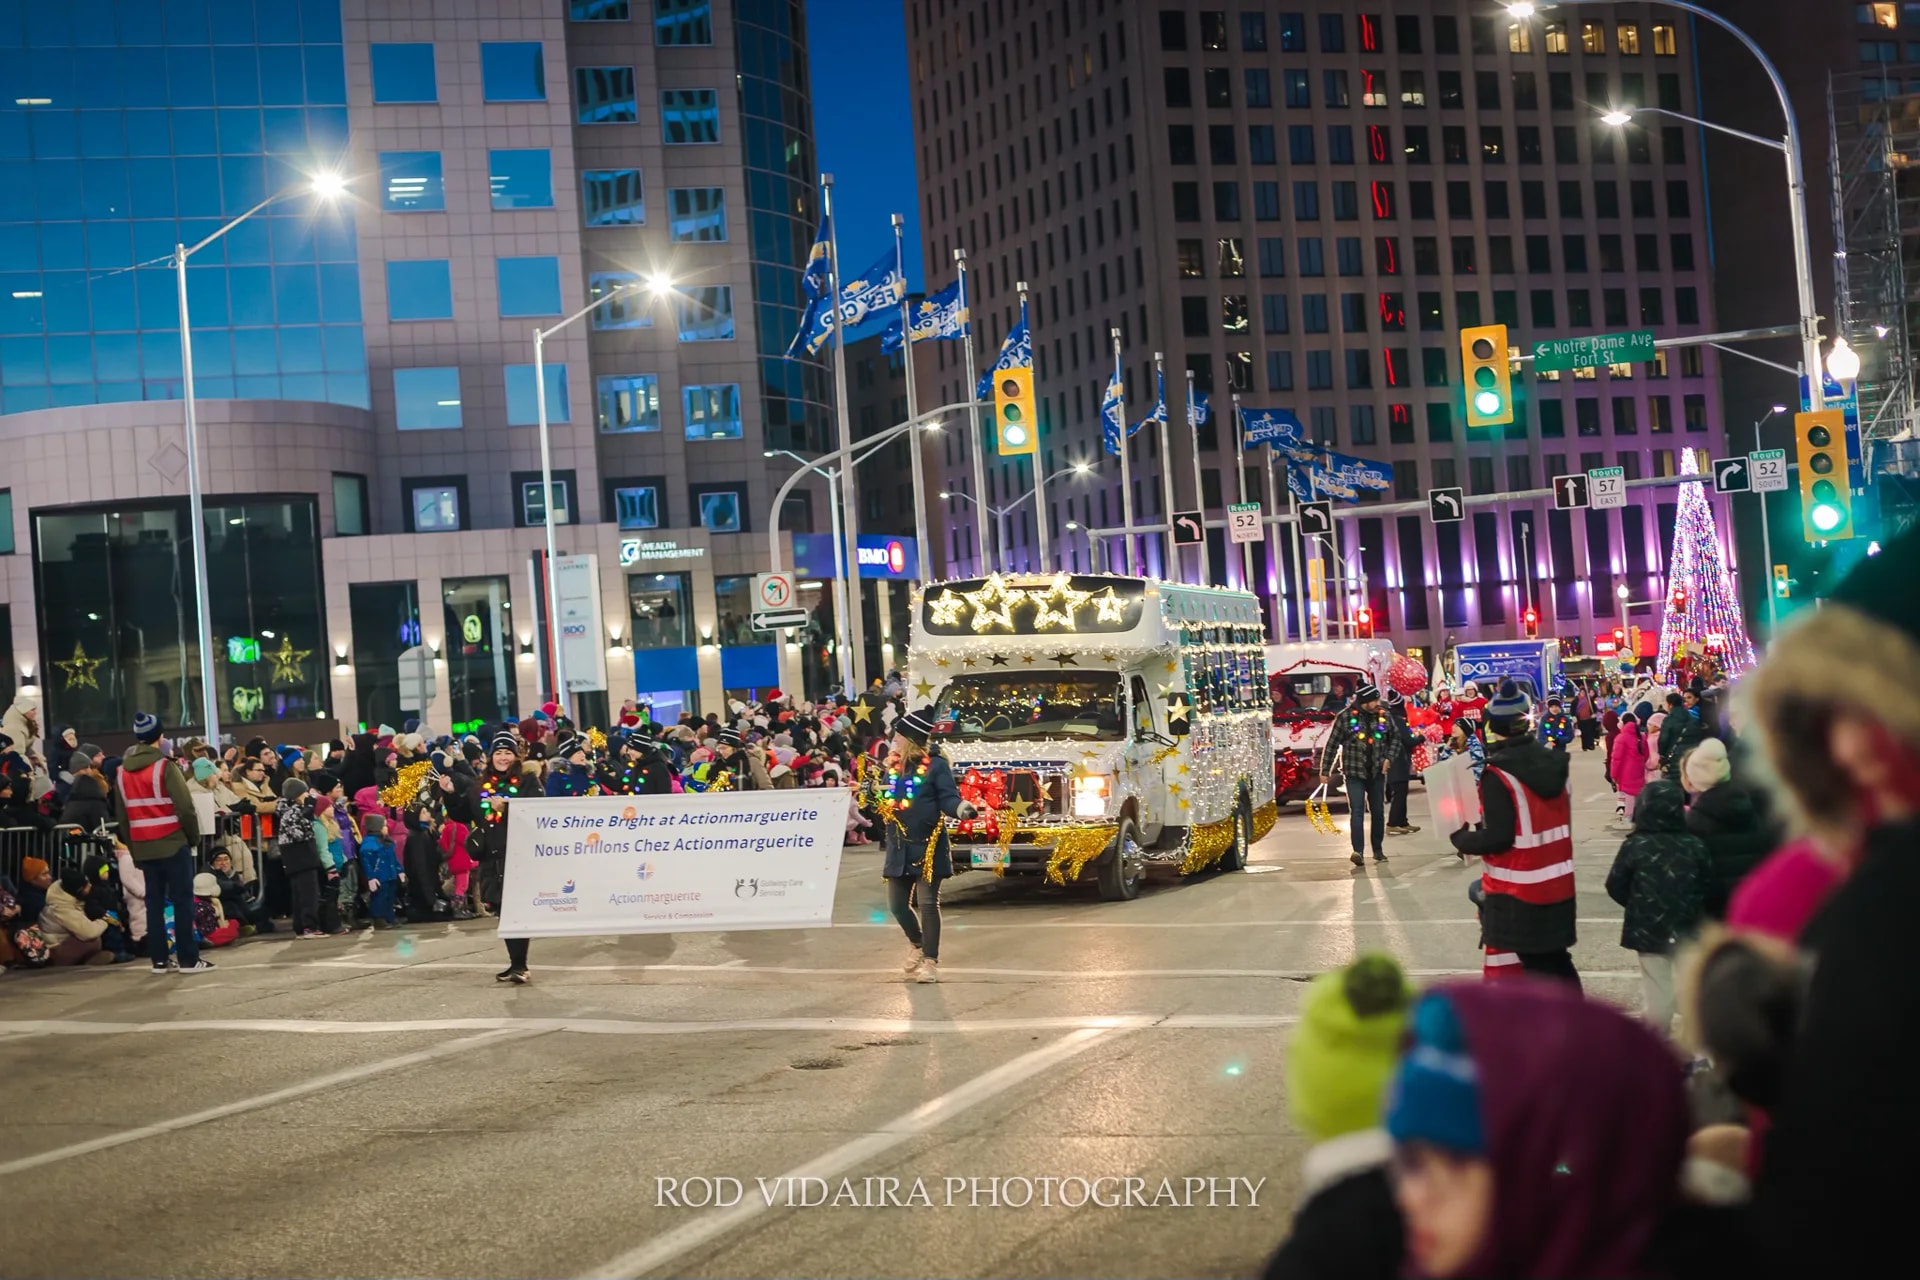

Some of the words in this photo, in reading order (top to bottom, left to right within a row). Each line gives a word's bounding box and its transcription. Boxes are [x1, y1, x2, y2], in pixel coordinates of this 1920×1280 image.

[1554, 341, 1587, 354] Notre
[1591, 336, 1625, 351] Dame
[1631, 333, 1652, 346] Ave
[1574, 352, 1598, 366] Fort
[1603, 351, 1615, 364] St
[1753, 451, 1781, 460] Route
[1592, 468, 1620, 477] Route
[1760, 462, 1778, 475] 52
[1600, 480, 1615, 492] 57
[1758, 480, 1781, 488] SOUTH
[1600, 496, 1617, 505] EAST
[1231, 504, 1258, 512] Route
[1236, 514, 1256, 527] 52
[1236, 531, 1258, 540] NORTH
[640, 541, 677, 550] WEALTH
[641, 548, 705, 560] MANAGEMENT
[857, 548, 889, 565] BMO
[563, 624, 586, 634] BDO
[536, 816, 558, 830] We
[562, 815, 604, 828] Shine
[608, 814, 655, 830] Bright
[659, 815, 676, 826] at
[678, 808, 818, 826] Actionmarguerite
[535, 844, 569, 857] Nous
[574, 840, 630, 855] Brillons
[634, 838, 670, 853] Chez
[673, 834, 814, 853] Actionmarguerite
[608, 891, 702, 906] Actionmarguerite
